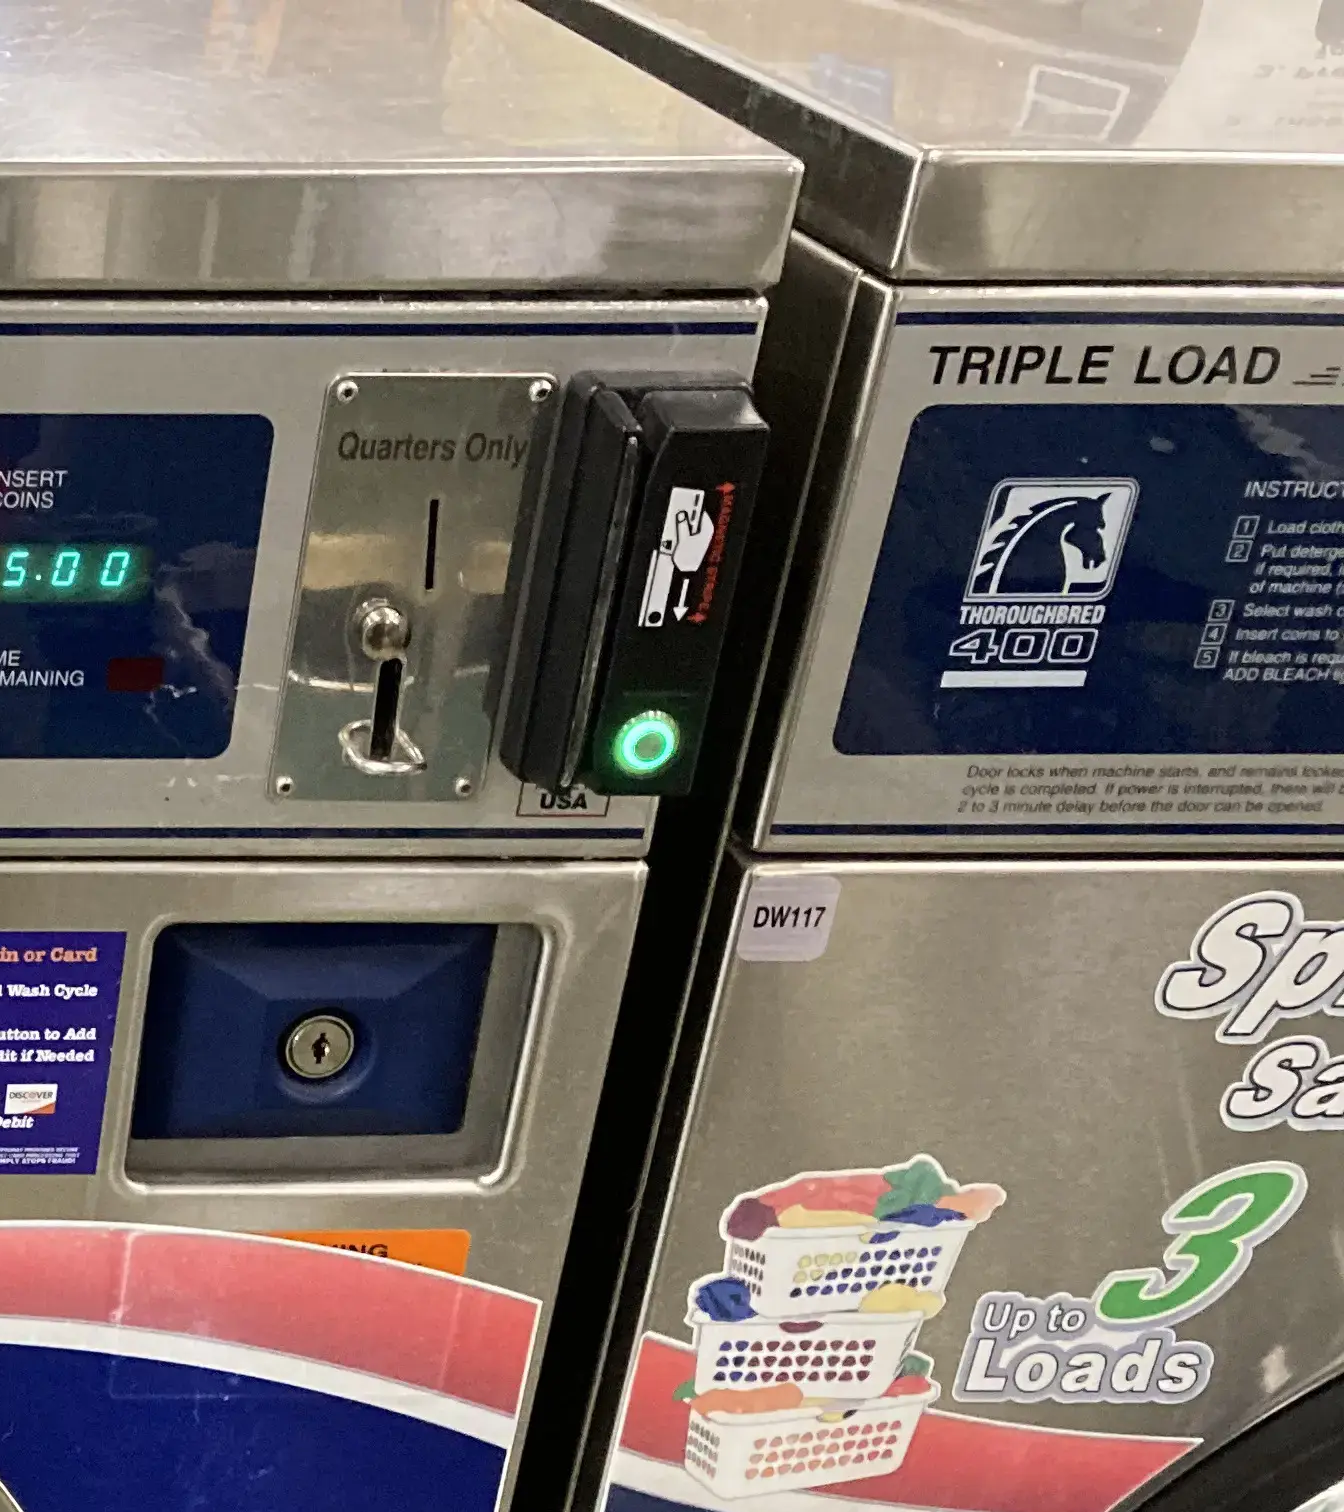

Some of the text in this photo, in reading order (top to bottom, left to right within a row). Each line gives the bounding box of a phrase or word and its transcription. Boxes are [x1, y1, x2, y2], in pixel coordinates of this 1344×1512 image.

[928, 346, 1281, 386] TRIPLE LOAD
[338, 431, 528, 468] Quarters Only
[2, 552, 130, 587] 5.00
[960, 605, 1105, 625] THOROUGHBRED
[948, 628, 1099, 663] 400
[539, 790, 588, 809] USA
[753, 905, 826, 929] DW117
[24, 950, 46, 962] or
[50, 948, 97, 962] Card
[8, 985, 50, 996] Wash
[54, 985, 98, 999] Cycle
[44, 1030, 60, 1040] to
[64, 1028, 96, 1040] Add
[20, 1050, 33, 1062] if
[36, 1050, 94, 1062] Needed
[9, 1091, 54, 1100] DISCOVER
[1097, 1169, 1300, 1321] 3
[984, 1302, 1086, 1334] Up to
[963, 1338, 1203, 1394] Loads
